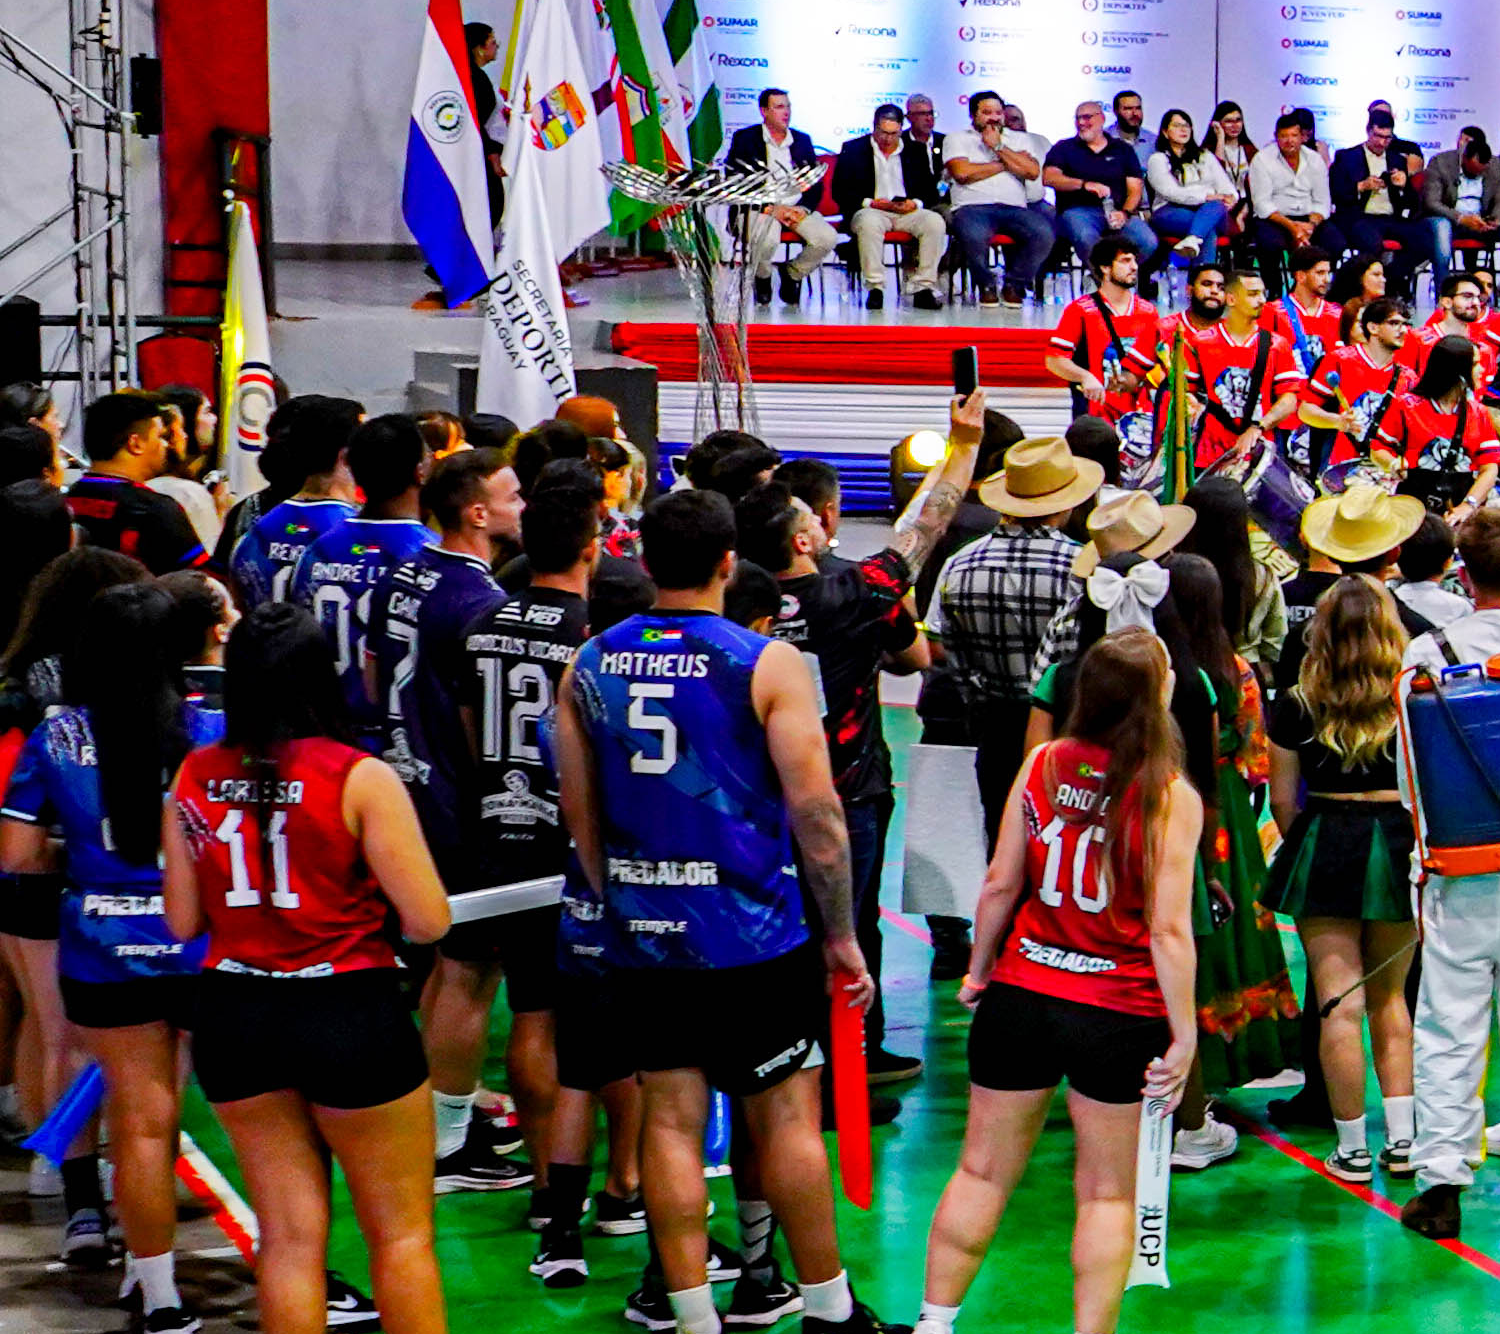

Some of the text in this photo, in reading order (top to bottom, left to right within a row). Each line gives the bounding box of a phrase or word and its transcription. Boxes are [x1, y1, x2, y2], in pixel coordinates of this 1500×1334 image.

[716, 17, 758, 28] SUMAR
[1407, 11, 1442, 21] SUMAR
[1293, 39, 1329, 48] SUMAR
[1408, 45, 1451, 58] Rexona
[718, 53, 768, 68] Rexona
[1094, 66, 1131, 74] SUMAR
[601, 651, 710, 679] MATHEUS
[476, 657, 553, 766] 12
[628, 682, 678, 774] 5
[216, 809, 301, 909] 11
[607, 859, 718, 886] PREDADOR
[629, 919, 688, 934] TEMPLE
[115, 942, 185, 958] TEMPLE
[755, 1038, 807, 1077] TEMPLE
[1138, 1204, 1164, 1268] #UCP
